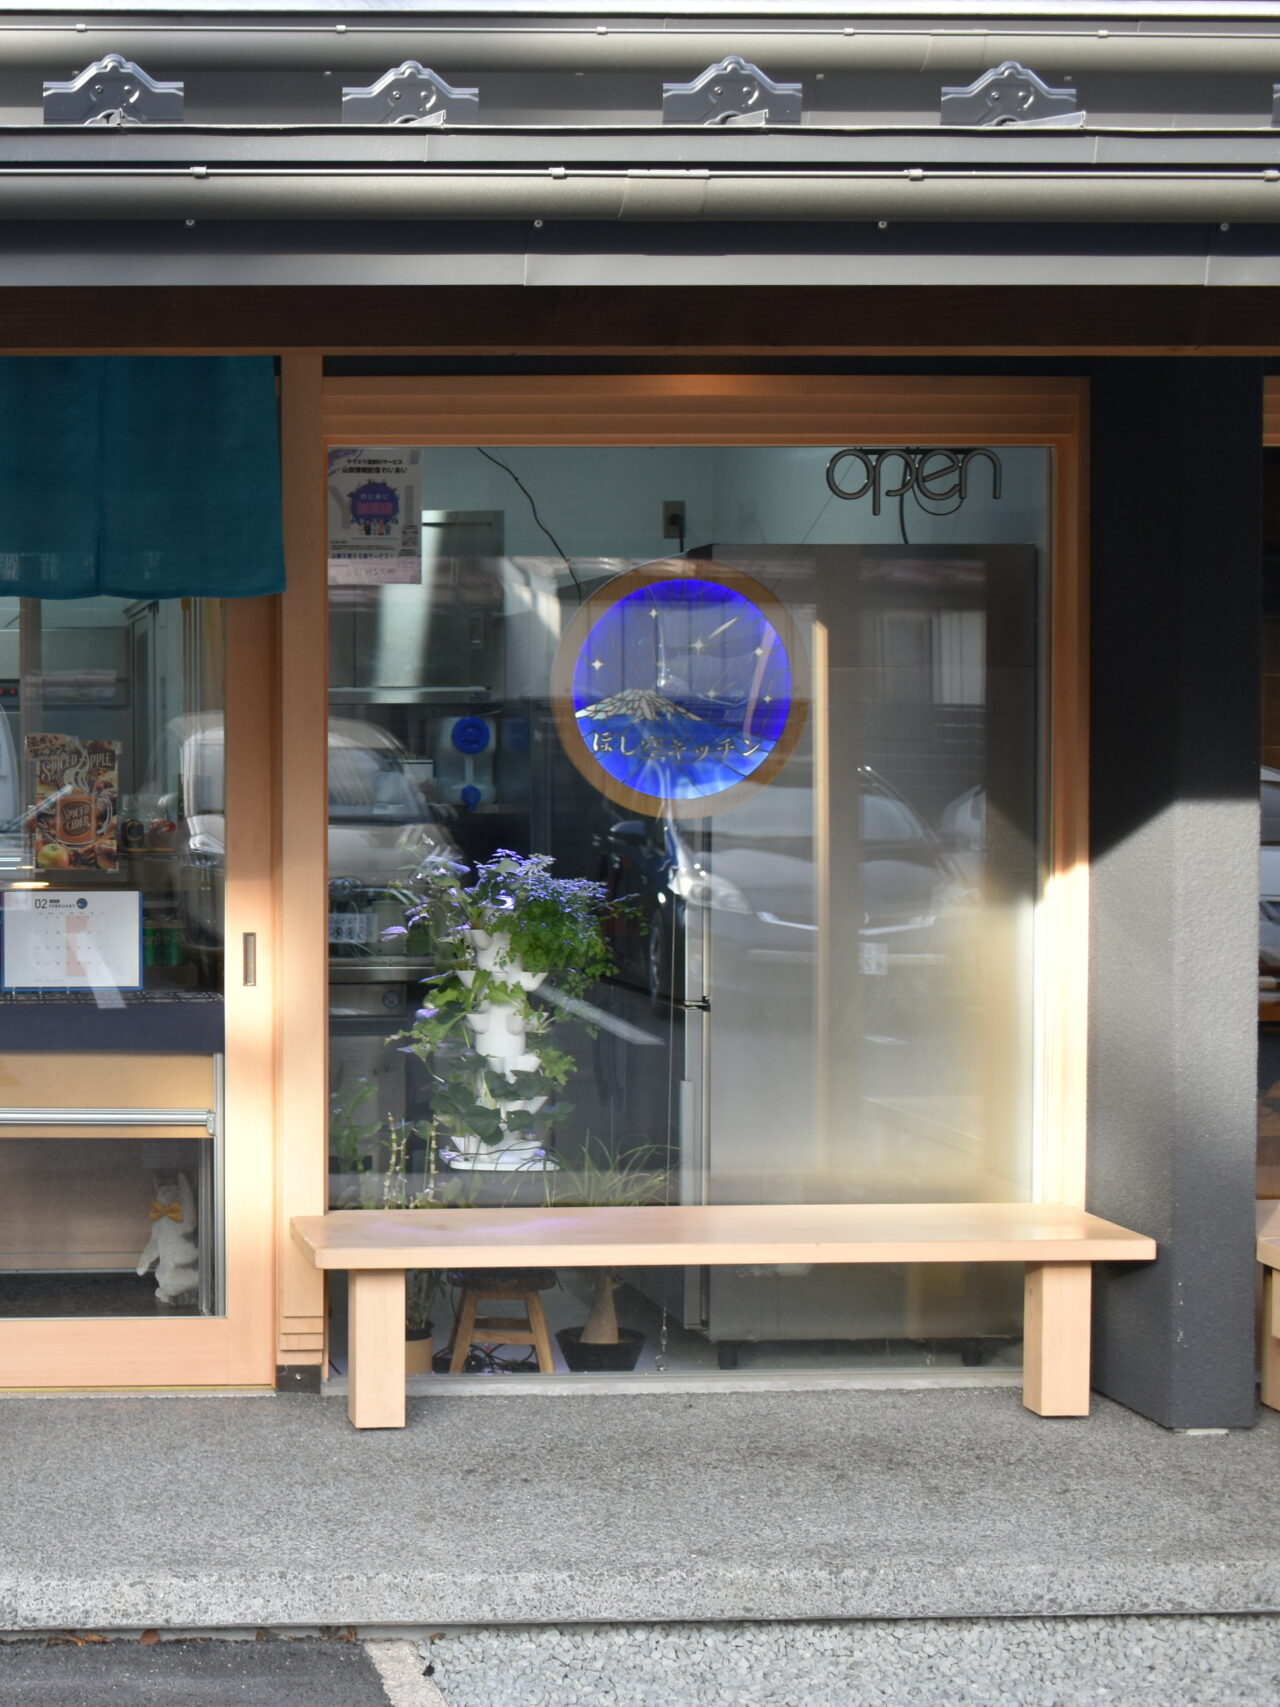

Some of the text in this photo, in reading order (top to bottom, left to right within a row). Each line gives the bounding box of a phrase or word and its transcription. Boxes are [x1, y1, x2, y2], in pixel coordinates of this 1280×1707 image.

[826, 448, 1002, 516] open
[593, 732, 760, 762] ほし空キッチン
[41, 753, 78, 783] SPICED
[62, 804, 90, 820] SPICED
[65, 815, 92, 831] CIDER
[34, 899, 48, 909] 02
